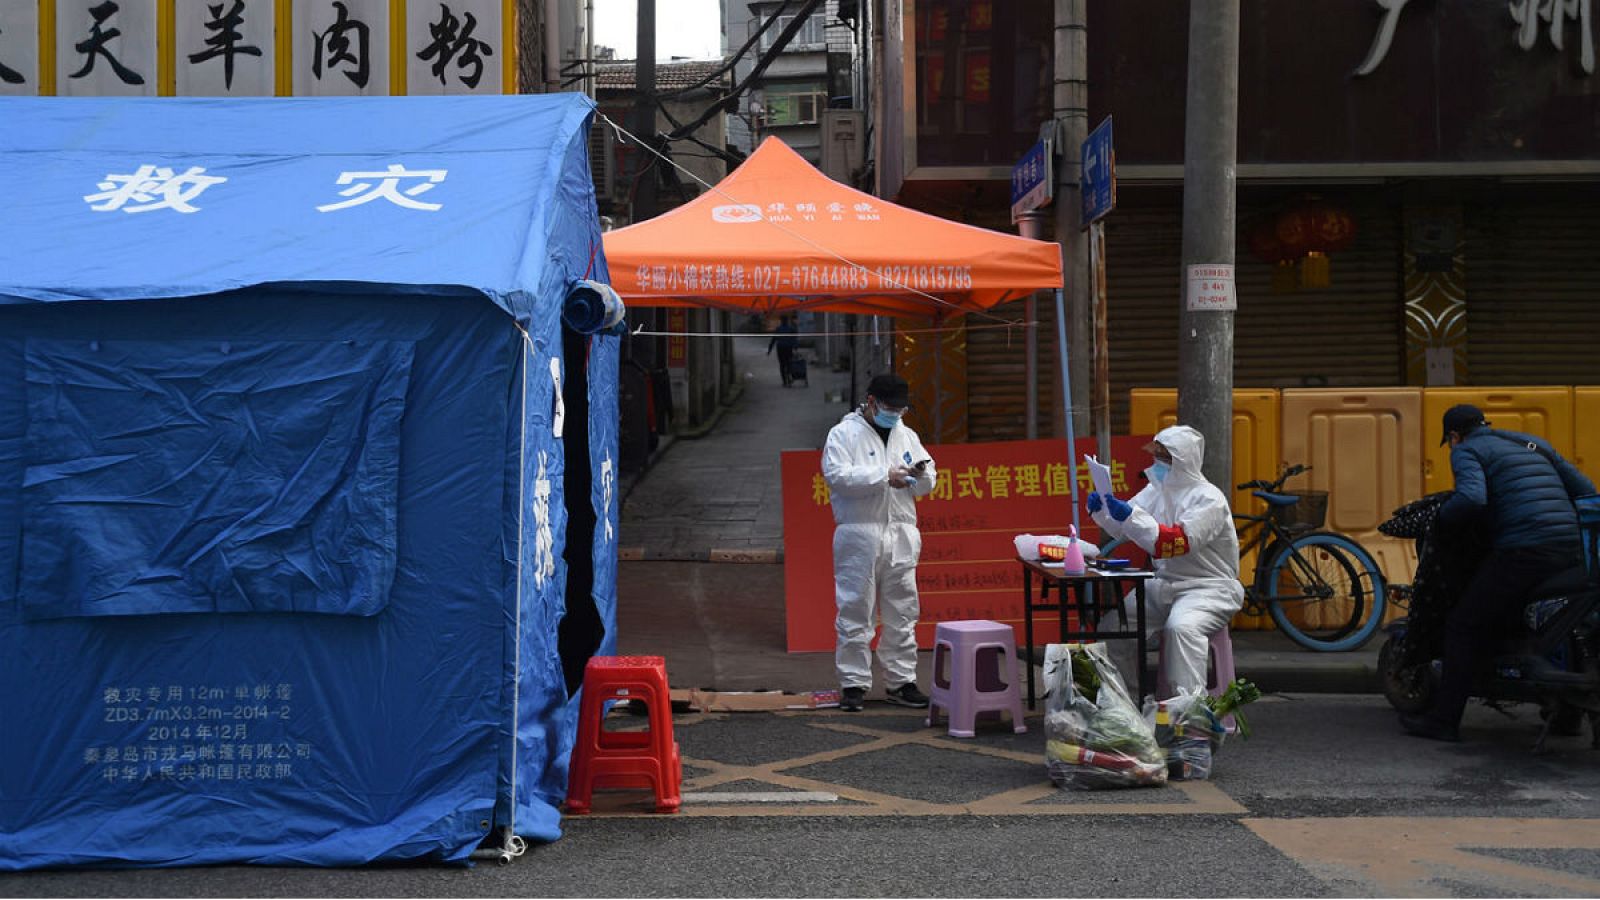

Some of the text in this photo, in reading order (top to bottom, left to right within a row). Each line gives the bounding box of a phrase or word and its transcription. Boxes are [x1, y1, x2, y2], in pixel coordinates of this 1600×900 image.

[0, 0, 493, 90] 天羊肉粉
[83, 163, 448, 215] 救灾
[103, 763, 292, 783] 中华人民共和国民政部
